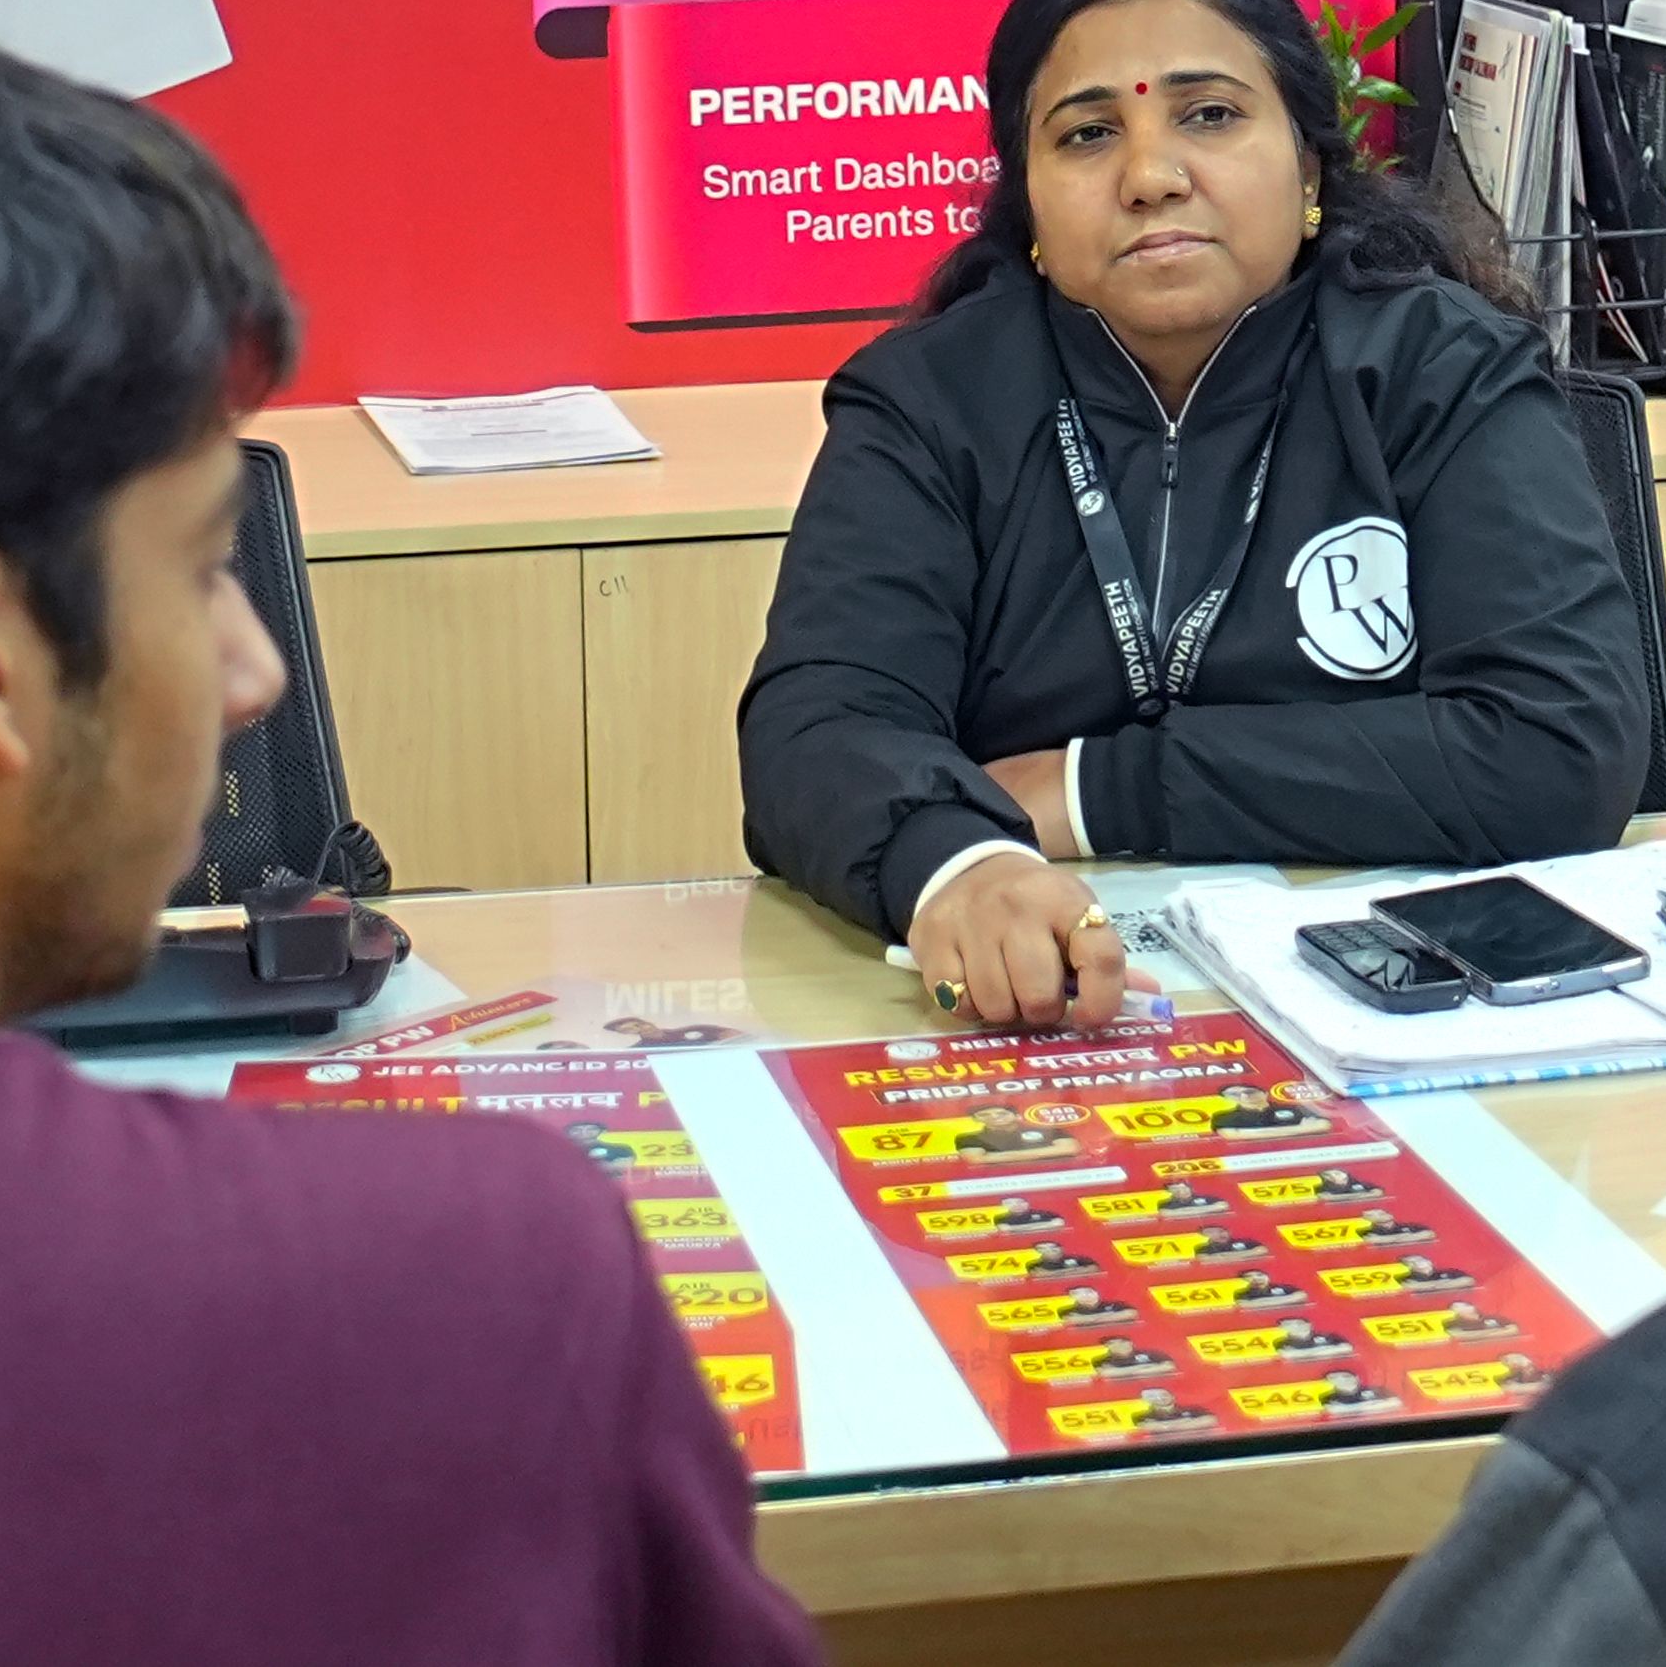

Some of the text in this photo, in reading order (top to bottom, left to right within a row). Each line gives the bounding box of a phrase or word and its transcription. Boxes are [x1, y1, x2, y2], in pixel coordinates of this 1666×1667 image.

[689, 76, 990, 127] PERFORMAN
[702, 151, 1003, 200] Smart Dashboa
[786, 204, 934, 244] Parents
[1104, 581, 1148, 698] VIDYAPEETH
[1165, 588, 1222, 695] VIDYAPEETH
[384, 1024, 435, 1051] PW
[949, 1037, 1020, 1052] NEET
[371, 1058, 651, 1078] JEE ADVANCED 20
[844, 1058, 1017, 1086] RESULT
[1168, 1039, 1247, 1061] PW
[884, 1063, 1245, 1104] PRIDE OF PRAYAGRAJ
[637, 1091, 667, 1109] P
[1113, 1108, 1211, 1131] 100
[642, 1143, 694, 1158] 23
[872, 1131, 934, 1154] 87
[1157, 1159, 1222, 1174] 206
[893, 1186, 933, 1199] 37
[1253, 1184, 1311, 1198] 575
[1091, 1198, 1146, 1214] 581
[644, 1212, 728, 1229] 363
[928, 1213, 991, 1229] 598
[1291, 1224, 1351, 1242] 567
[1126, 1241, 1182, 1258] 571
[960, 1256, 1021, 1273] 574
[1329, 1271, 1393, 1289] 559
[1166, 1287, 1218, 1304] 561
[988, 1304, 1055, 1322] 565
[1375, 1320, 1434, 1337] 551
[1200, 1336, 1269, 1356] 554
[1021, 1355, 1091, 1374] 556
[1418, 1370, 1489, 1391] 545
[1240, 1389, 1314, 1410] 546
[1062, 1410, 1121, 1429] 551
